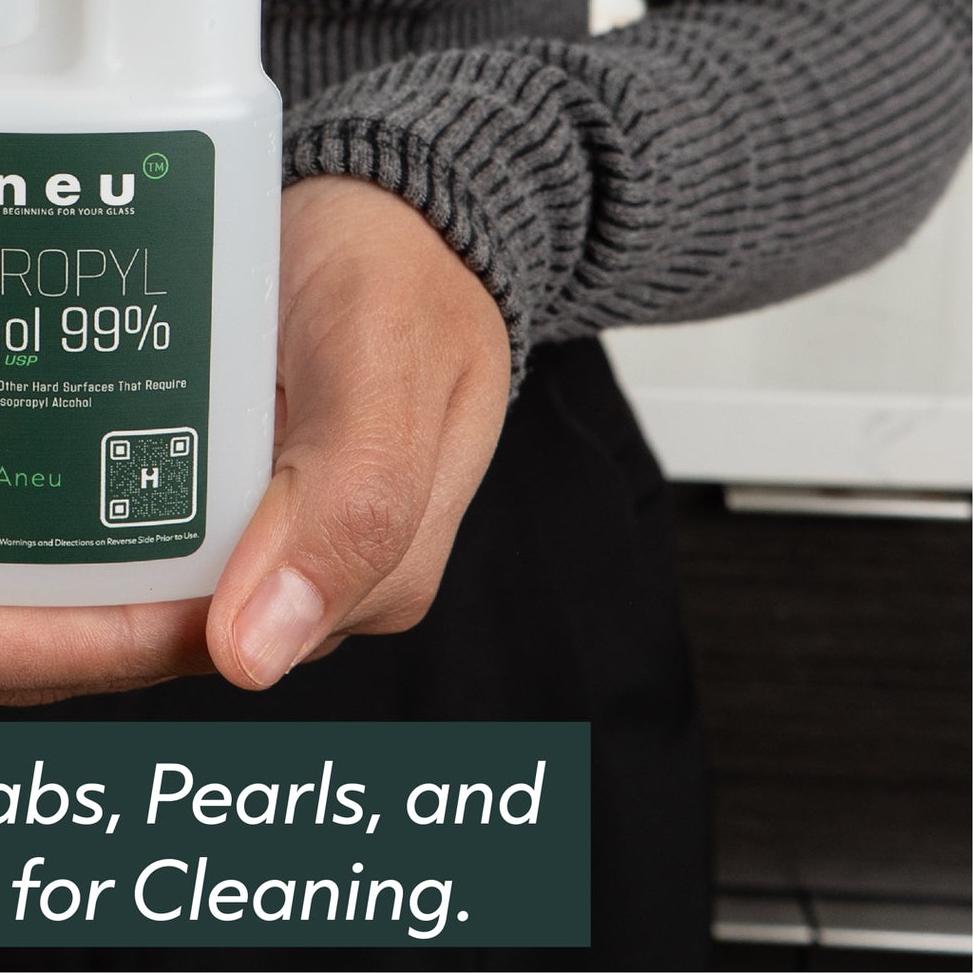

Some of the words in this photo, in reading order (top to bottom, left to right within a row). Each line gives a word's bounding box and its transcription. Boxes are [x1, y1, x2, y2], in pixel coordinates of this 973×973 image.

[3, 207, 54, 216] BEGINNING
[57, 208, 76, 216] FOR
[78, 208, 104, 216] YOUR
[106, 207, 135, 215] GLASS
[61, 305, 171, 352] 99%
[5, 355, 38, 366] USP
[32, 380, 58, 393] Hard
[63, 381, 114, 393] Surfaces
[119, 380, 142, 392] That
[146, 378, 187, 391] Require
[52, 397, 92, 408] Alcohol
[0, 538, 36, 548] Warnings
[38, 539, 53, 547] and
[55, 538, 93, 547] Directions
[107, 537, 137, 546] Reverse
[138, 535, 154, 544] Side
[156, 533, 173, 543] Prior
[184, 532, 199, 540] Use.
